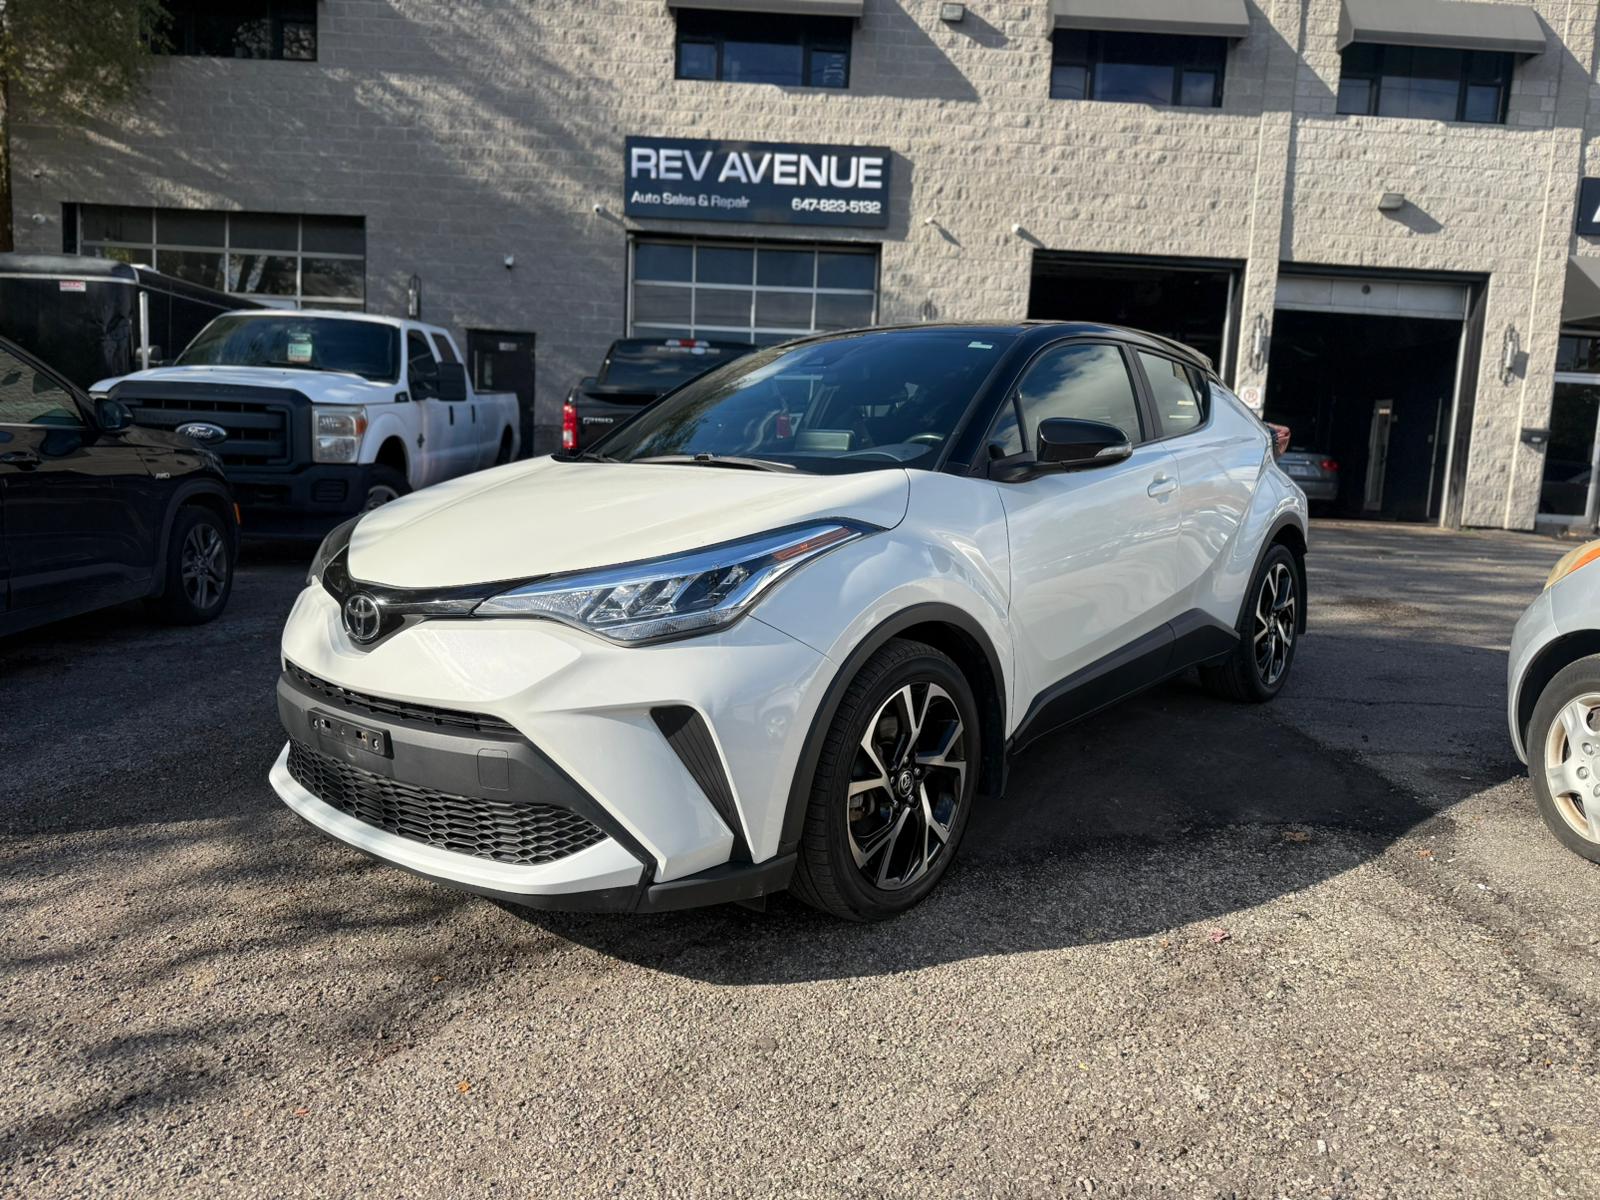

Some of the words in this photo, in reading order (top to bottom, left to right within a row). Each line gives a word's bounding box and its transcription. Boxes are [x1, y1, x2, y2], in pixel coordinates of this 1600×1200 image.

[630, 147, 713, 182] REV
[718, 151, 883, 189] AVENUE
[631, 190, 661, 204] Auto
[662, 192, 696, 206] Sales
[698, 194, 708, 207] &
[711, 195, 750, 209] Repair
[791, 197, 882, 214] 647-823-5132
